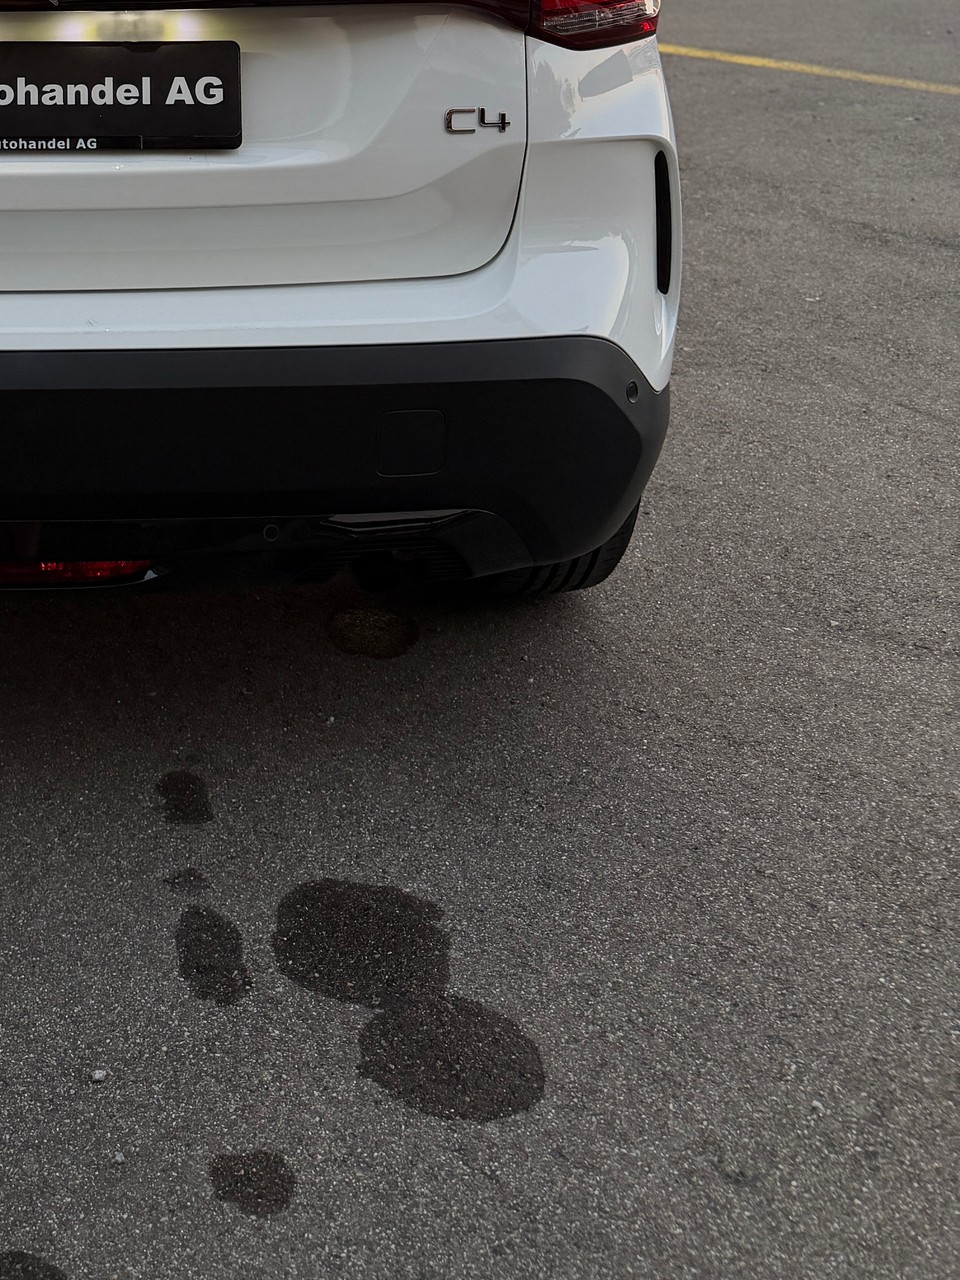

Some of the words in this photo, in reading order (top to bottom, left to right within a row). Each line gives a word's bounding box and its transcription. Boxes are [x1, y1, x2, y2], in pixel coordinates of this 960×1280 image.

[165, 76, 225, 106] AG
[444, 106, 511, 135] C4
[76, 138, 98, 150] AG
